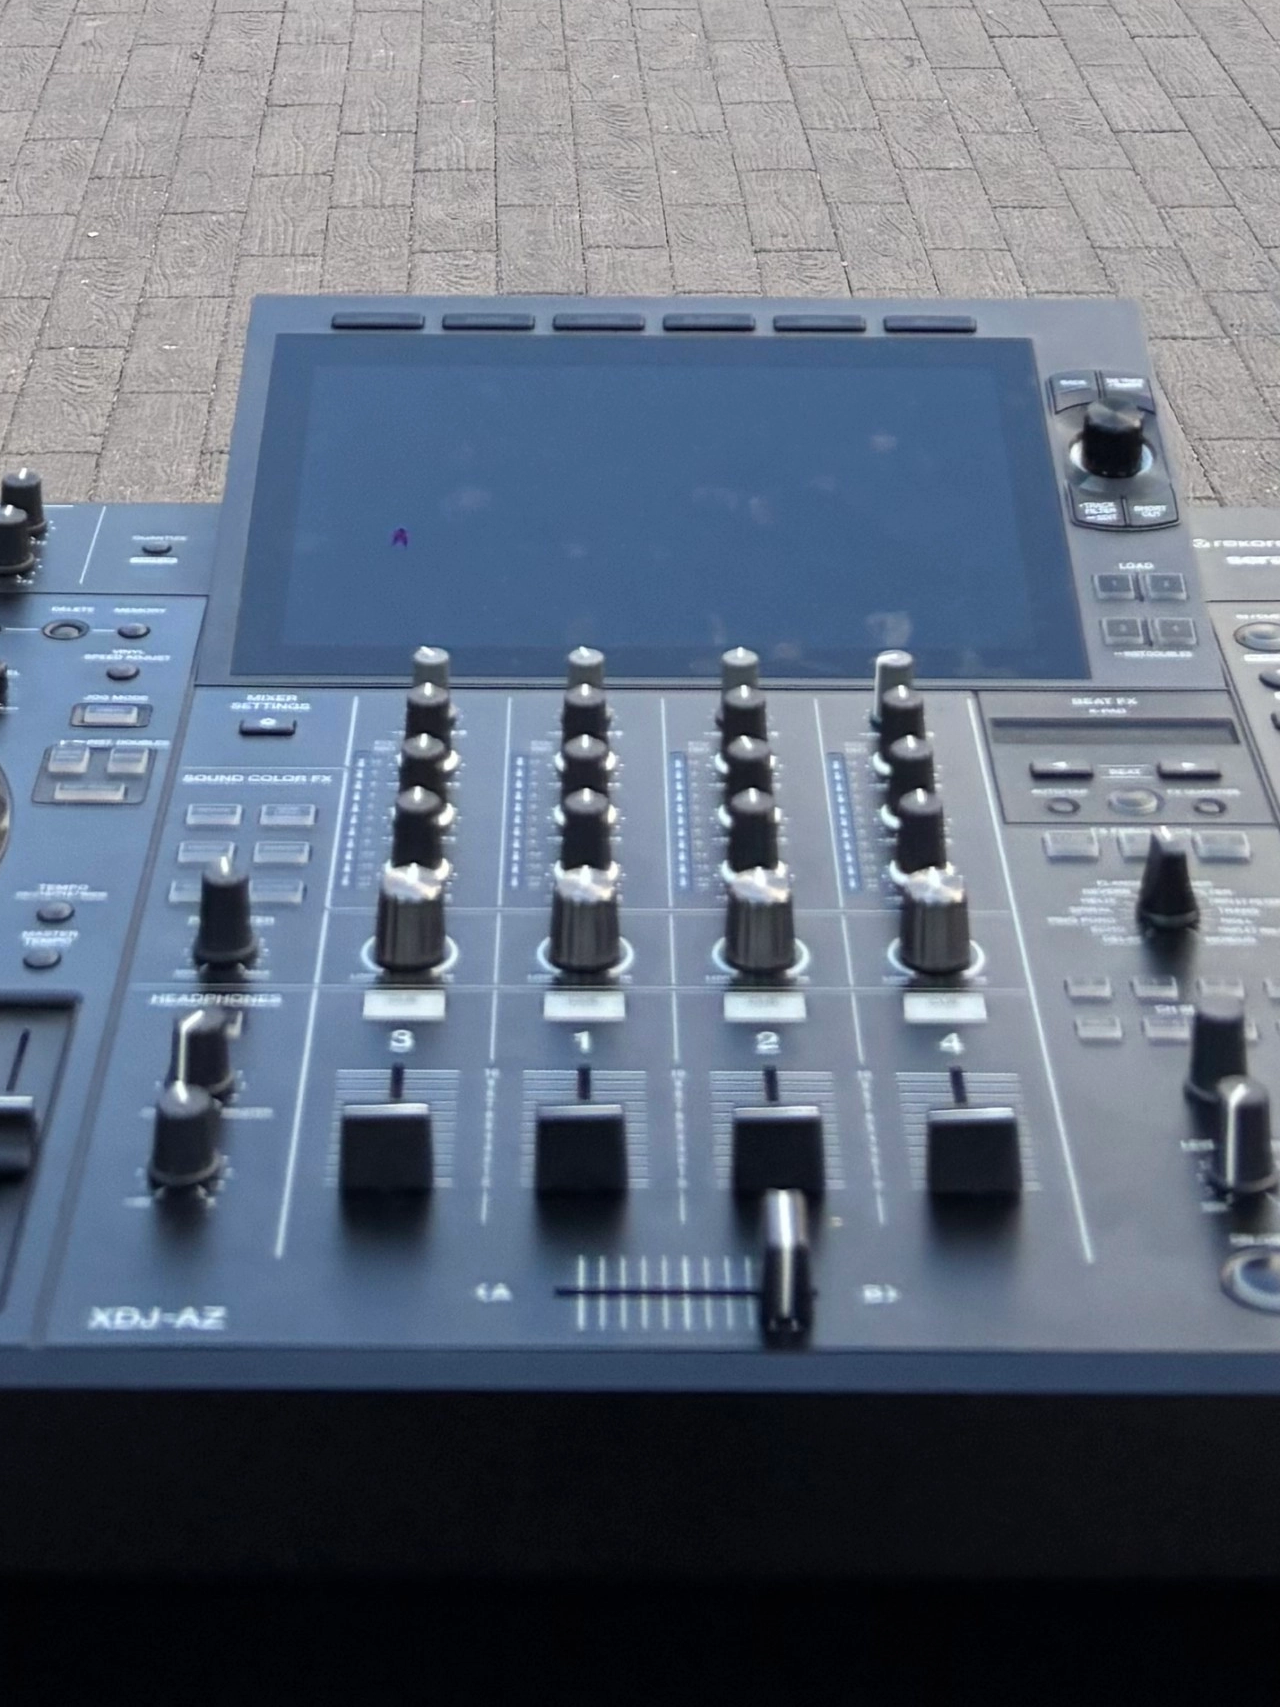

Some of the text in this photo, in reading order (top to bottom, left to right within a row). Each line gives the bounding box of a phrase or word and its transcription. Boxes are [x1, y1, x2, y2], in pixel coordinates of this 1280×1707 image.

[183, 773, 333, 784] SOUND COLOR FX
[149, 992, 283, 1007] HEADPHONES
[755, 1031, 781, 1054] 2
[939, 1032, 966, 1054] 4
[87, 1306, 227, 1331] XDJ-AZ
